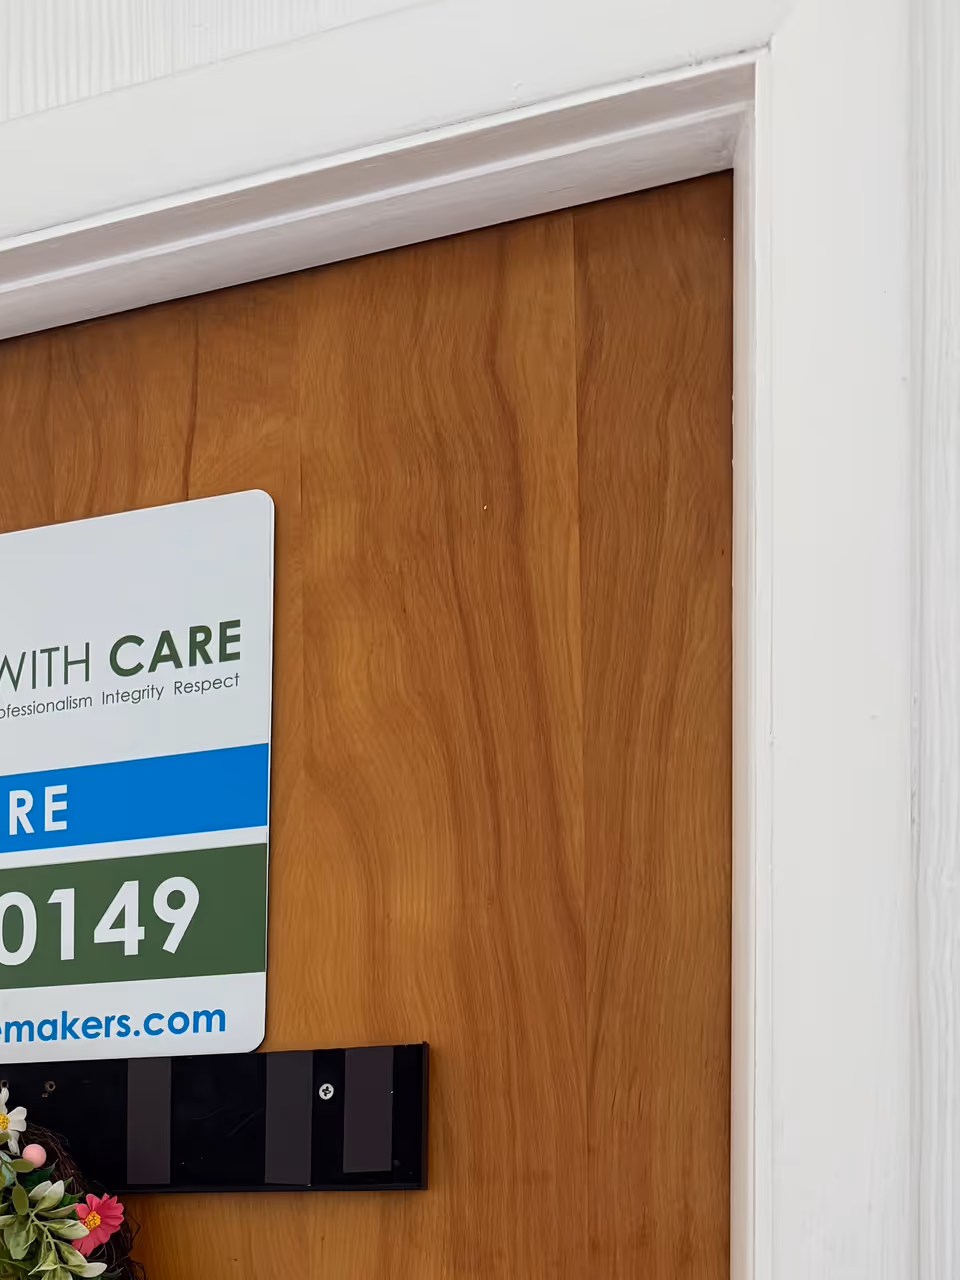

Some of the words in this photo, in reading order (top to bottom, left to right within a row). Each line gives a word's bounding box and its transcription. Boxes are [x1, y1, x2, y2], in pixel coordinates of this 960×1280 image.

[109, 619, 241, 678] CARE
[102, 684, 165, 705] Integrity
[174, 673, 241, 696] Respect
